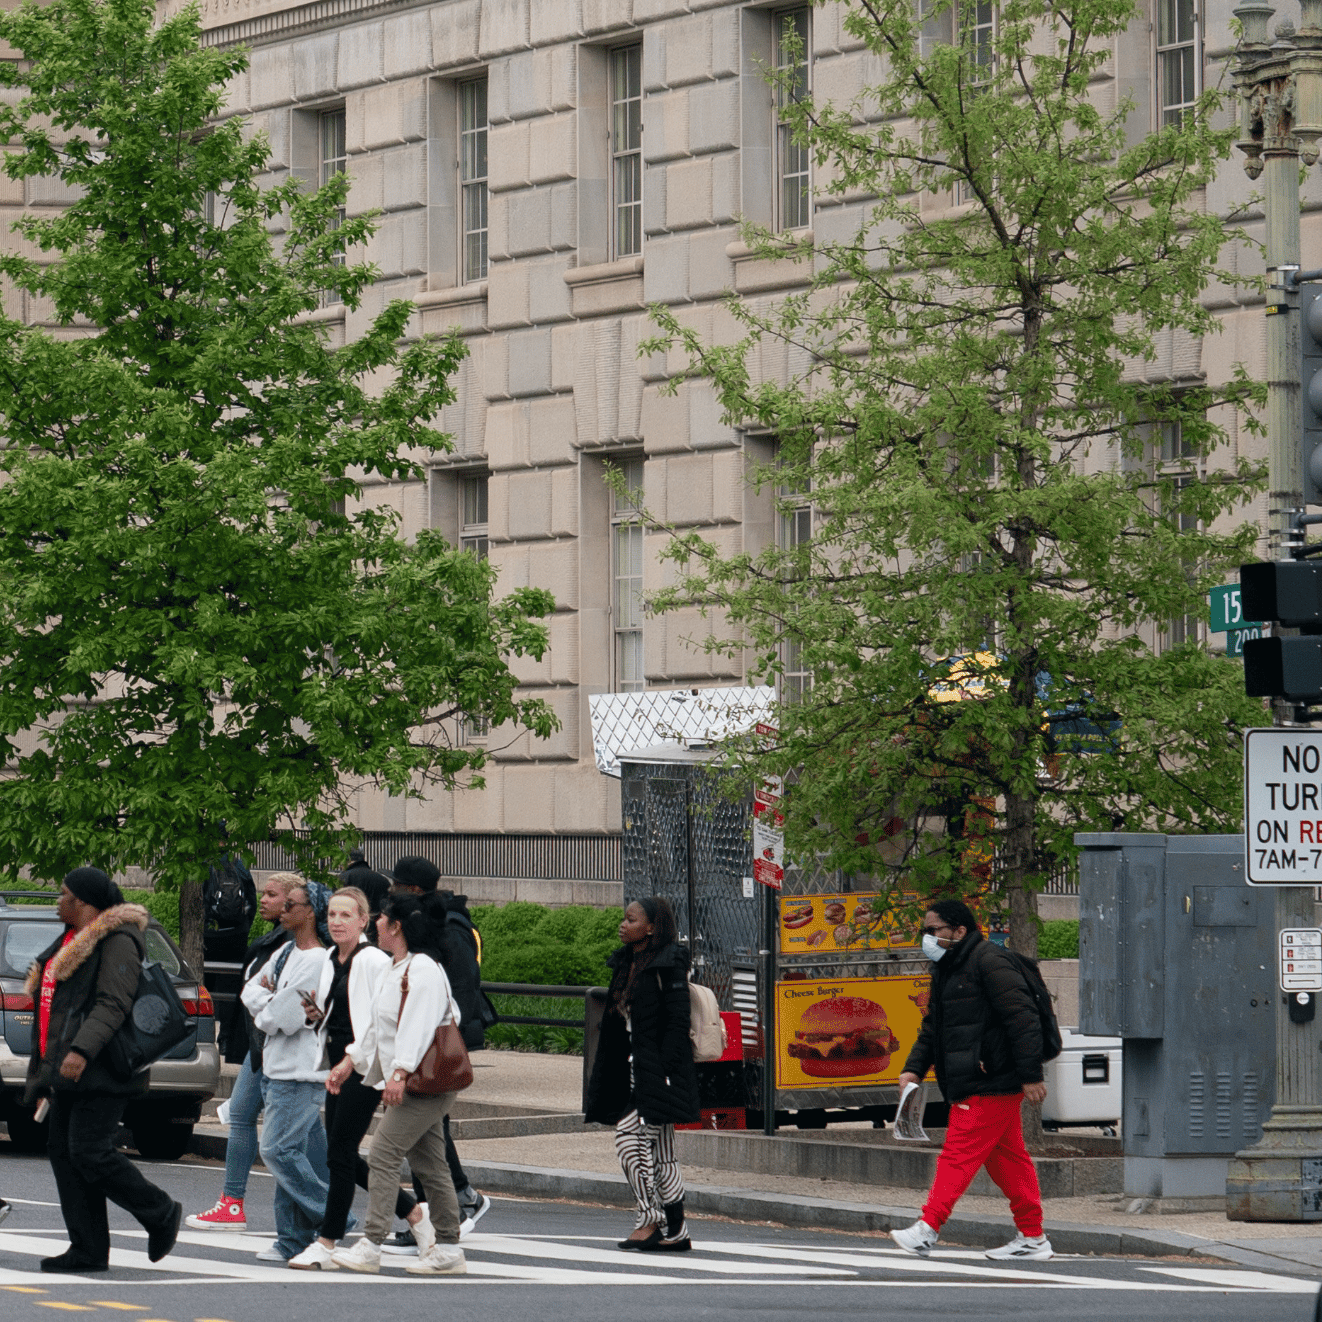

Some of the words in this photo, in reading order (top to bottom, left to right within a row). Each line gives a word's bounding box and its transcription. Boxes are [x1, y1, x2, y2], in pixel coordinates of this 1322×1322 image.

[1223, 590, 1241, 624] 15
[1283, 745, 1320, 773] NO
[1265, 783, 1322, 811] TUR
[1257, 819, 1288, 843] ON
[784, 989, 815, 999] Cheese
[817, 986, 845, 998] Burger
